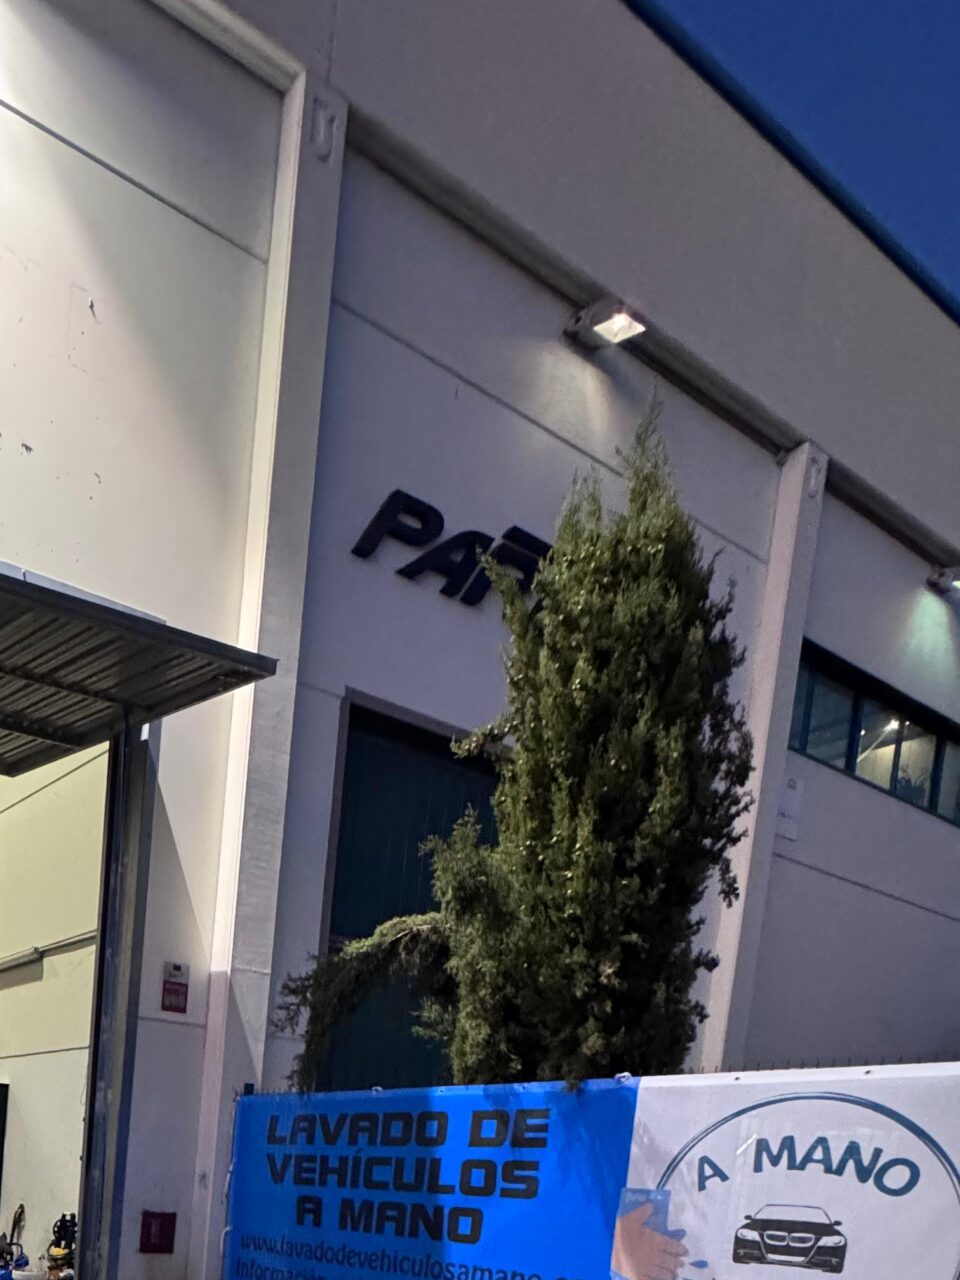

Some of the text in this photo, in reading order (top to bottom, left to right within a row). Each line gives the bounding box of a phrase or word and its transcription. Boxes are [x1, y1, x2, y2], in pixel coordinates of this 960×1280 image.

[266, 1108, 550, 1149] LAVADO DE
[266, 1148, 540, 1200] VEHÍCULOS
[697, 1135, 921, 1197] A MANO
[296, 1195, 483, 1245] A MANO
